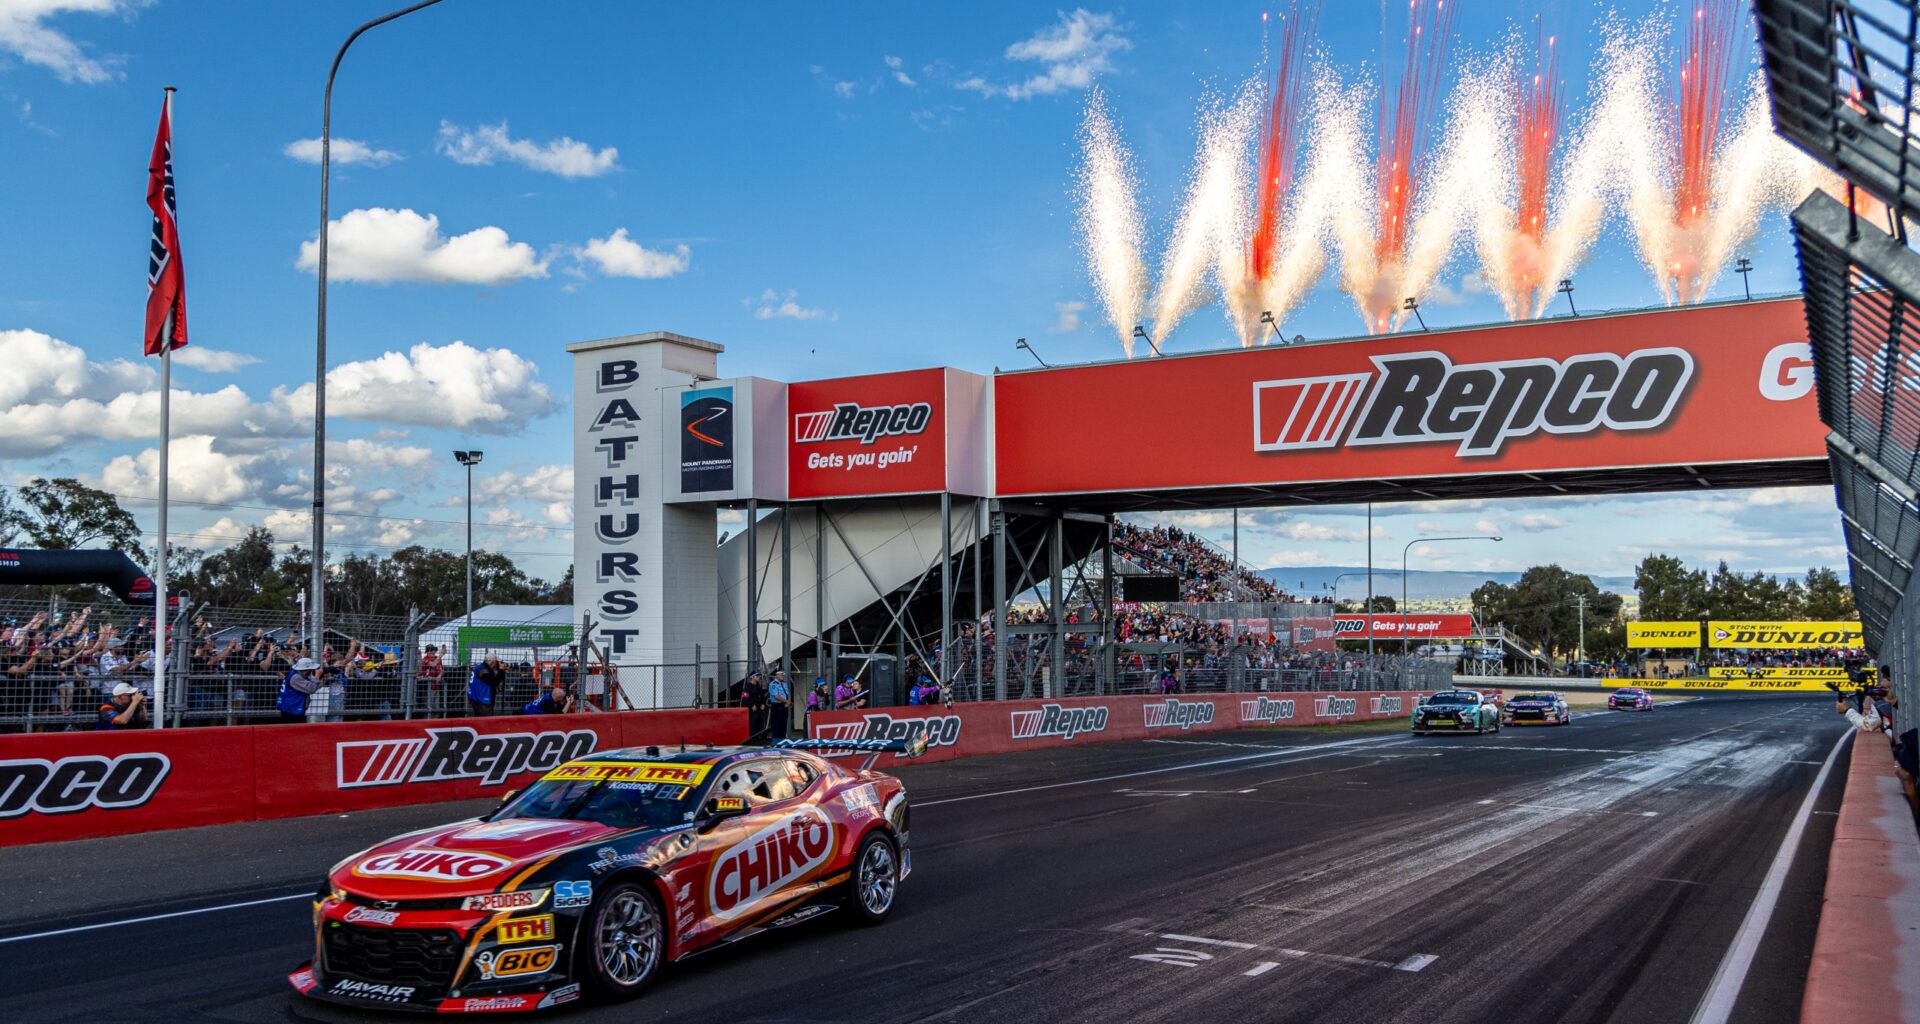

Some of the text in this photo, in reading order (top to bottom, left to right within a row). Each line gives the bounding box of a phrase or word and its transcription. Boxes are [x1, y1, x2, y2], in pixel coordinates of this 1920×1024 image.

[1348, 348, 1693, 455] Repco
[826, 403, 931, 443] Repco
[808, 445, 917, 471] Gets you goin'
[592, 360, 641, 655] BATHURST
[510, 629, 543, 640] Merlin
[1335, 620, 1365, 634] pco
[1372, 621, 1395, 630] Gets
[1417, 621, 1441, 632] goin'
[1732, 631, 1863, 644] DUNLOP
[1165, 699, 1214, 730] Repco
[1257, 697, 1294, 723] Repco
[1327, 695, 1356, 719] Repco
[1380, 694, 1401, 715] Repco
[1038, 704, 1108, 739] Repco
[778, 738, 893, 746] NAVAIR
[411, 728, 596, 785] Repco
[553, 767, 587, 777] TFH
[646, 767, 690, 780] TFH
[609, 781, 656, 792] Kostecki
[721, 799, 741, 807] TFH
[365, 852, 505, 877] CHIKO
[715, 820, 829, 911] CHIKO
[555, 880, 592, 898] SS
[484, 892, 533, 909] PEDDERS
[502, 919, 546, 938] TFH
[335, 979, 416, 997] NAVAIR
